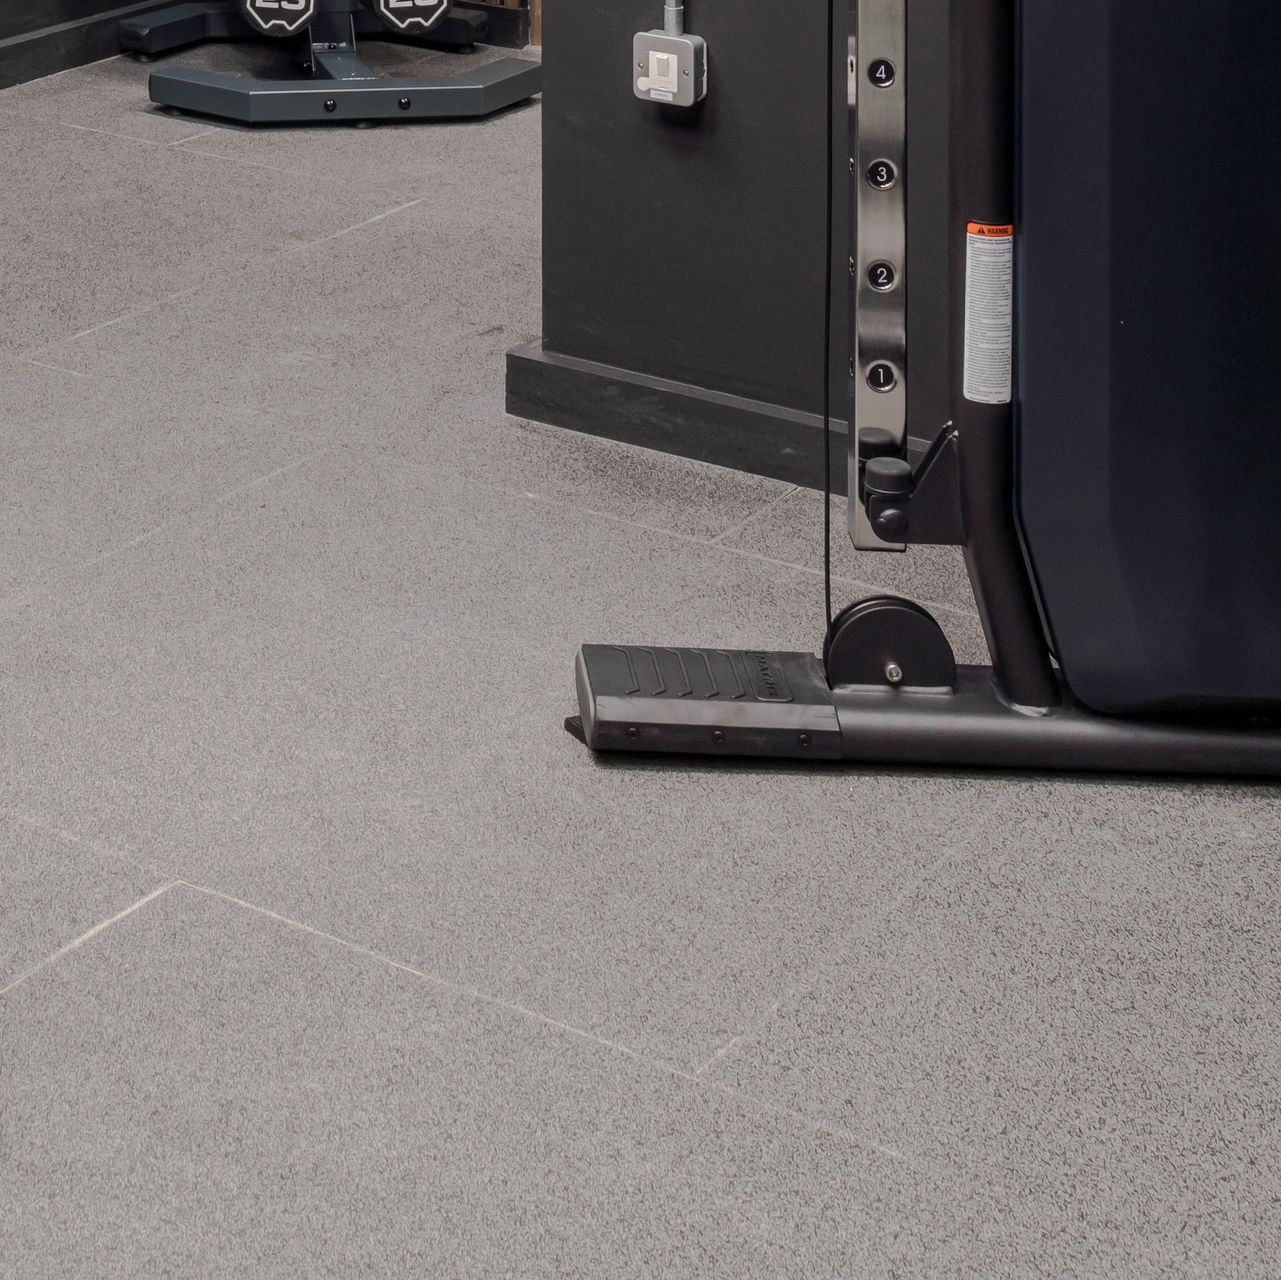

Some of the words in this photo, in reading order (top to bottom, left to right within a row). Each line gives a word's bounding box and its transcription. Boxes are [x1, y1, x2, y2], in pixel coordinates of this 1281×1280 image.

[875, 64, 887, 80] 4
[876, 166, 887, 182] 3
[876, 267, 888, 283] 2
[877, 368, 884, 384] 1
